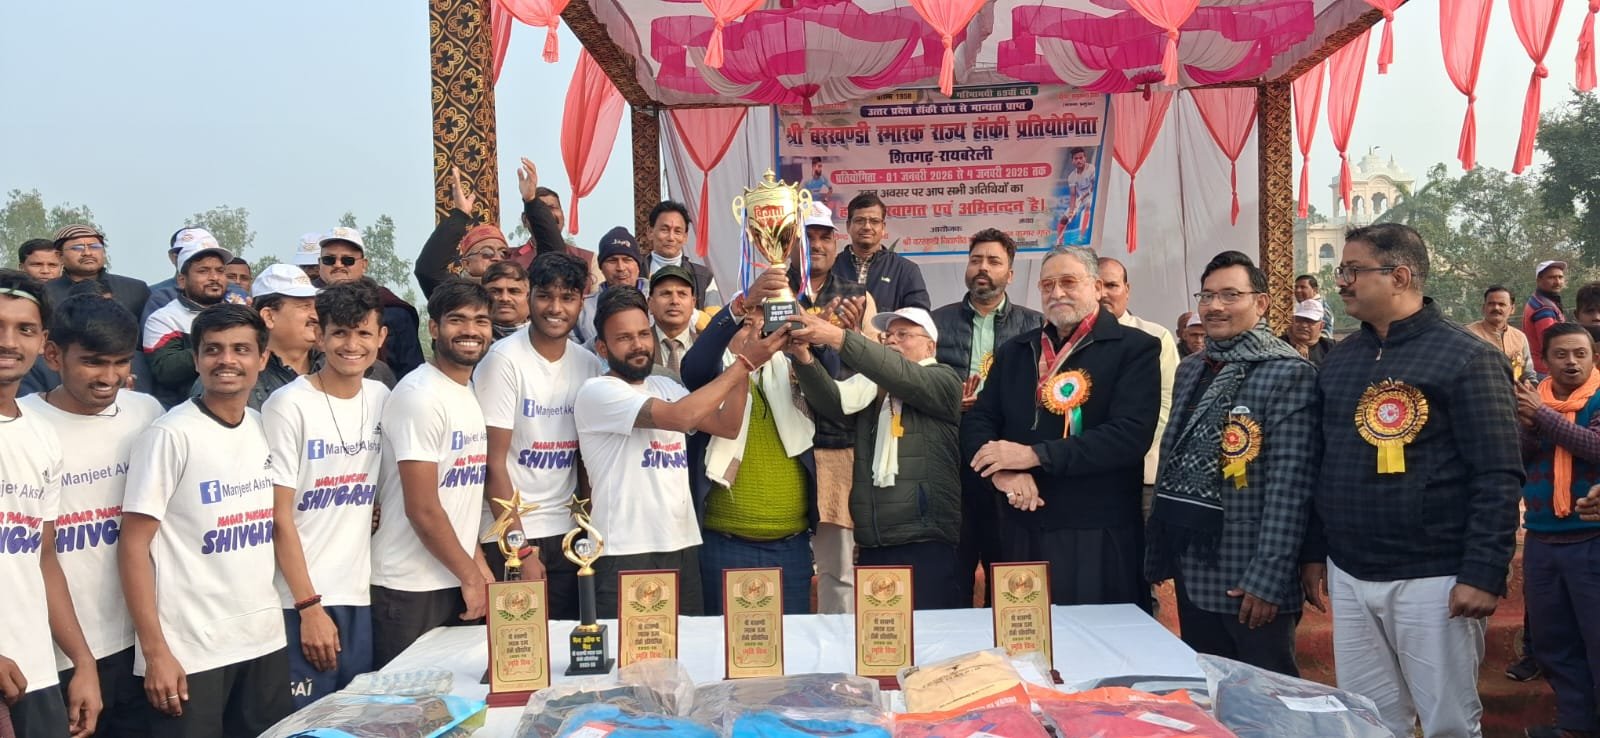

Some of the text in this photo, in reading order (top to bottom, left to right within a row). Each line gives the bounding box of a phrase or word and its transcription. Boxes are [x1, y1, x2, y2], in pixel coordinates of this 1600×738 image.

[891, 106, 912, 116] प्रदेश
[786, 122, 804, 146] श्री
[876, 123, 926, 145] स्मारक
[930, 121, 967, 143] राज्य
[972, 114, 1010, 142] हॉकी
[1015, 113, 1098, 140] प्रतियोगिता
[835, 170, 877, 184] प्रतियोगिता
[900, 169, 927, 182] जनवरी
[929, 170, 953, 181] 2026
[956, 168, 964, 180] से
[966, 169, 974, 179] 4
[976, 166, 1002, 179] जनवरी
[1005, 167, 1028, 178] 2026
[1031, 166, 1047, 177] तक
[880, 188, 910, 198] अवसर
[911, 188, 925, 197] पर
[927, 187, 944, 197] आप
[946, 183, 966, 196] सभी
[968, 182, 1009, 195] अतिथियों
[1010, 183, 1024, 193] का
[931, 200, 953, 217] एवं
[958, 199, 1024, 216] अभिनन्दन
[61, 465, 112, 487] Manjeet
[222, 480, 252, 498] Manjeet
